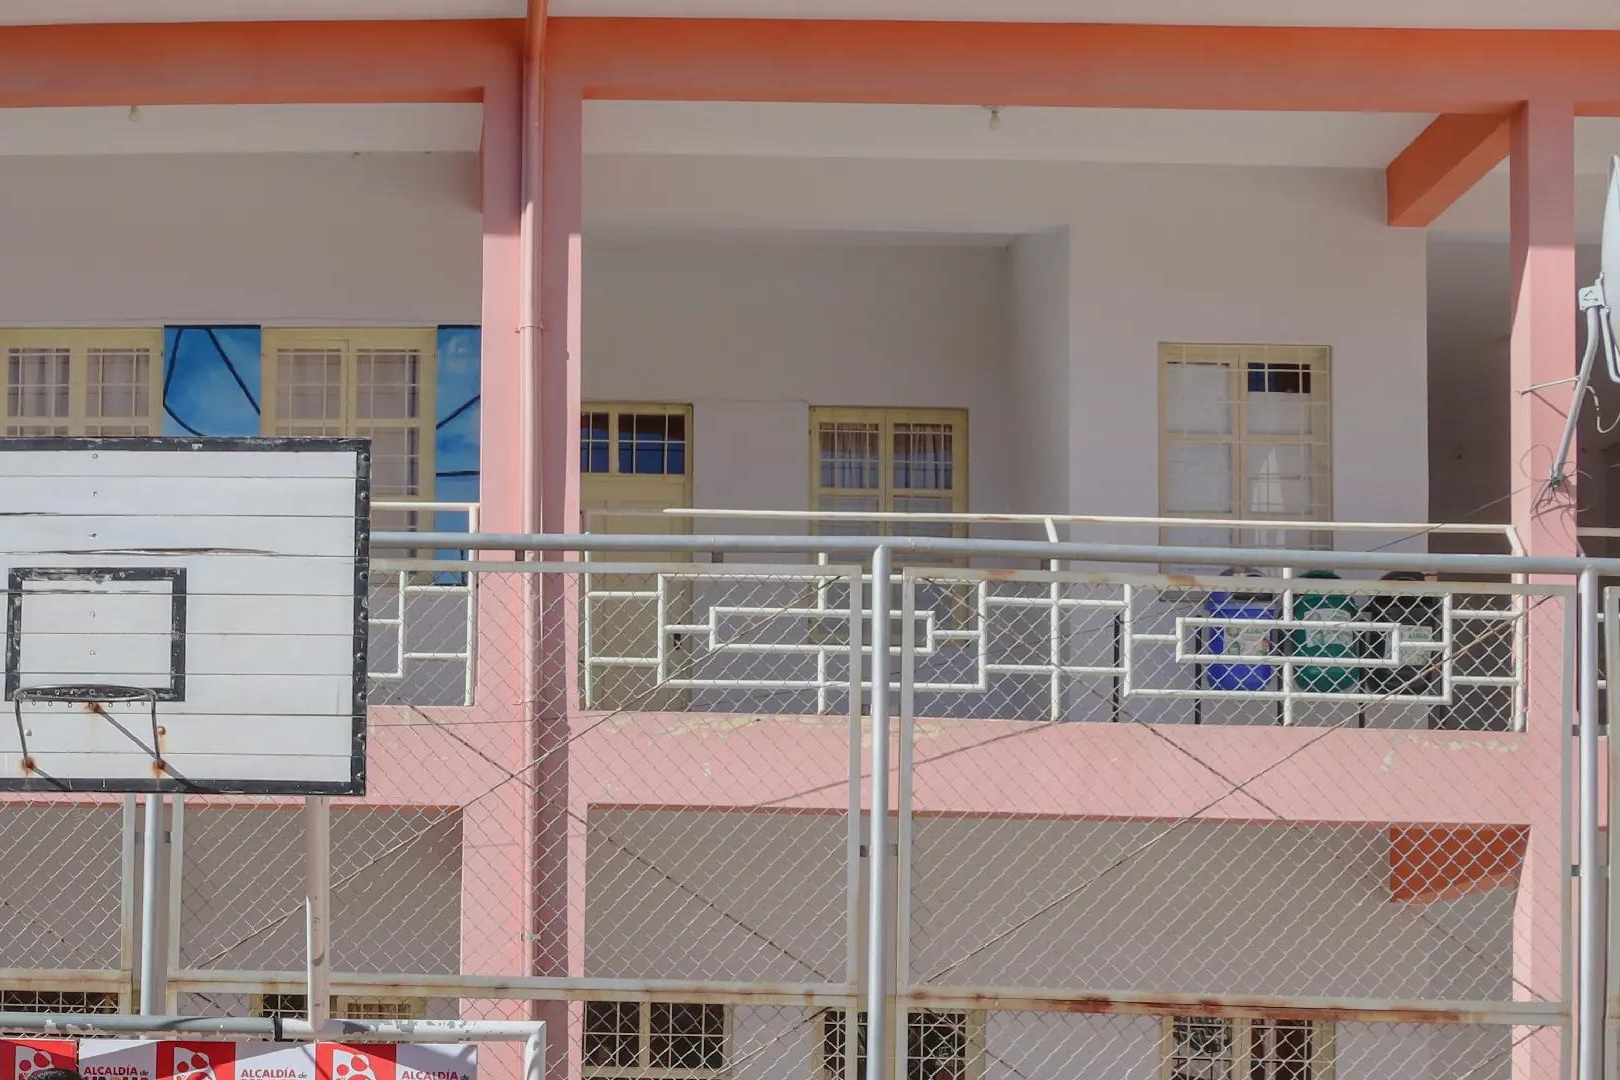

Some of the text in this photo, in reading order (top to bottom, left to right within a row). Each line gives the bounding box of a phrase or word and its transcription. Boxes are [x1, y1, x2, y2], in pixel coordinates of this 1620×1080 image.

[84, 1065, 138, 1075] ALCALDÍA
[240, 1067, 296, 1078] ALCALDÍA
[402, 1069, 458, 1080] ALCALDÍA
